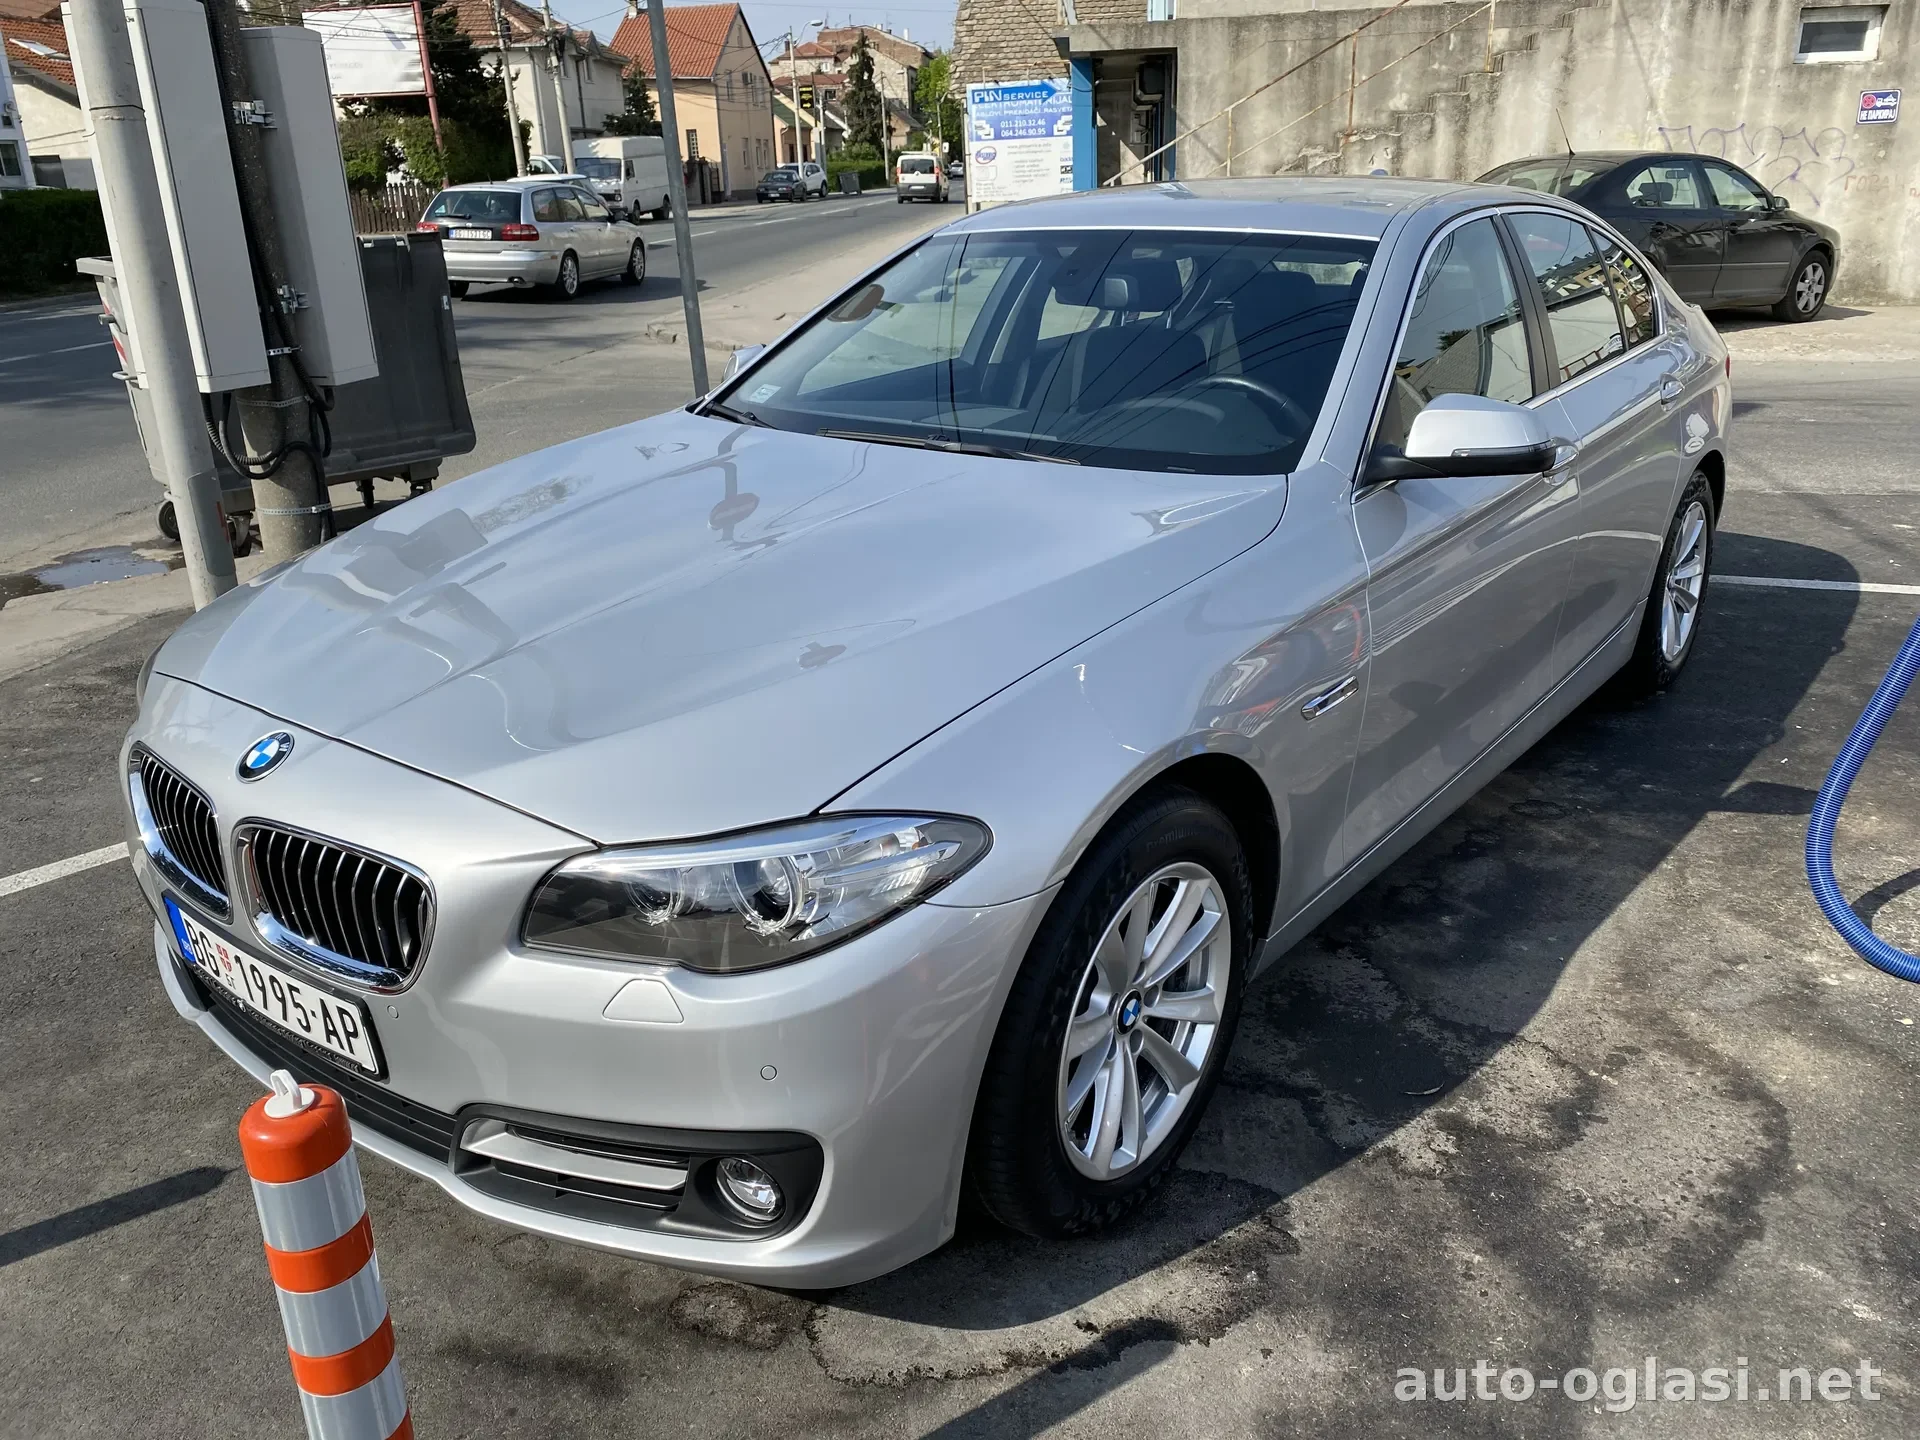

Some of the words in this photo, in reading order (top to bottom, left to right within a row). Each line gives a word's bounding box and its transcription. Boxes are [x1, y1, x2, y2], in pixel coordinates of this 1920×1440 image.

[974, 90, 1002, 102] PIN
[1003, 91, 1049, 101] SERVICE
[1860, 110, 1868, 120] НЕ
[1868, 109, 1896, 120] ПАРКИРАЈ
[1001, 128, 1046, 137] 064.246.90.95
[183, 918, 220, 978] BG
